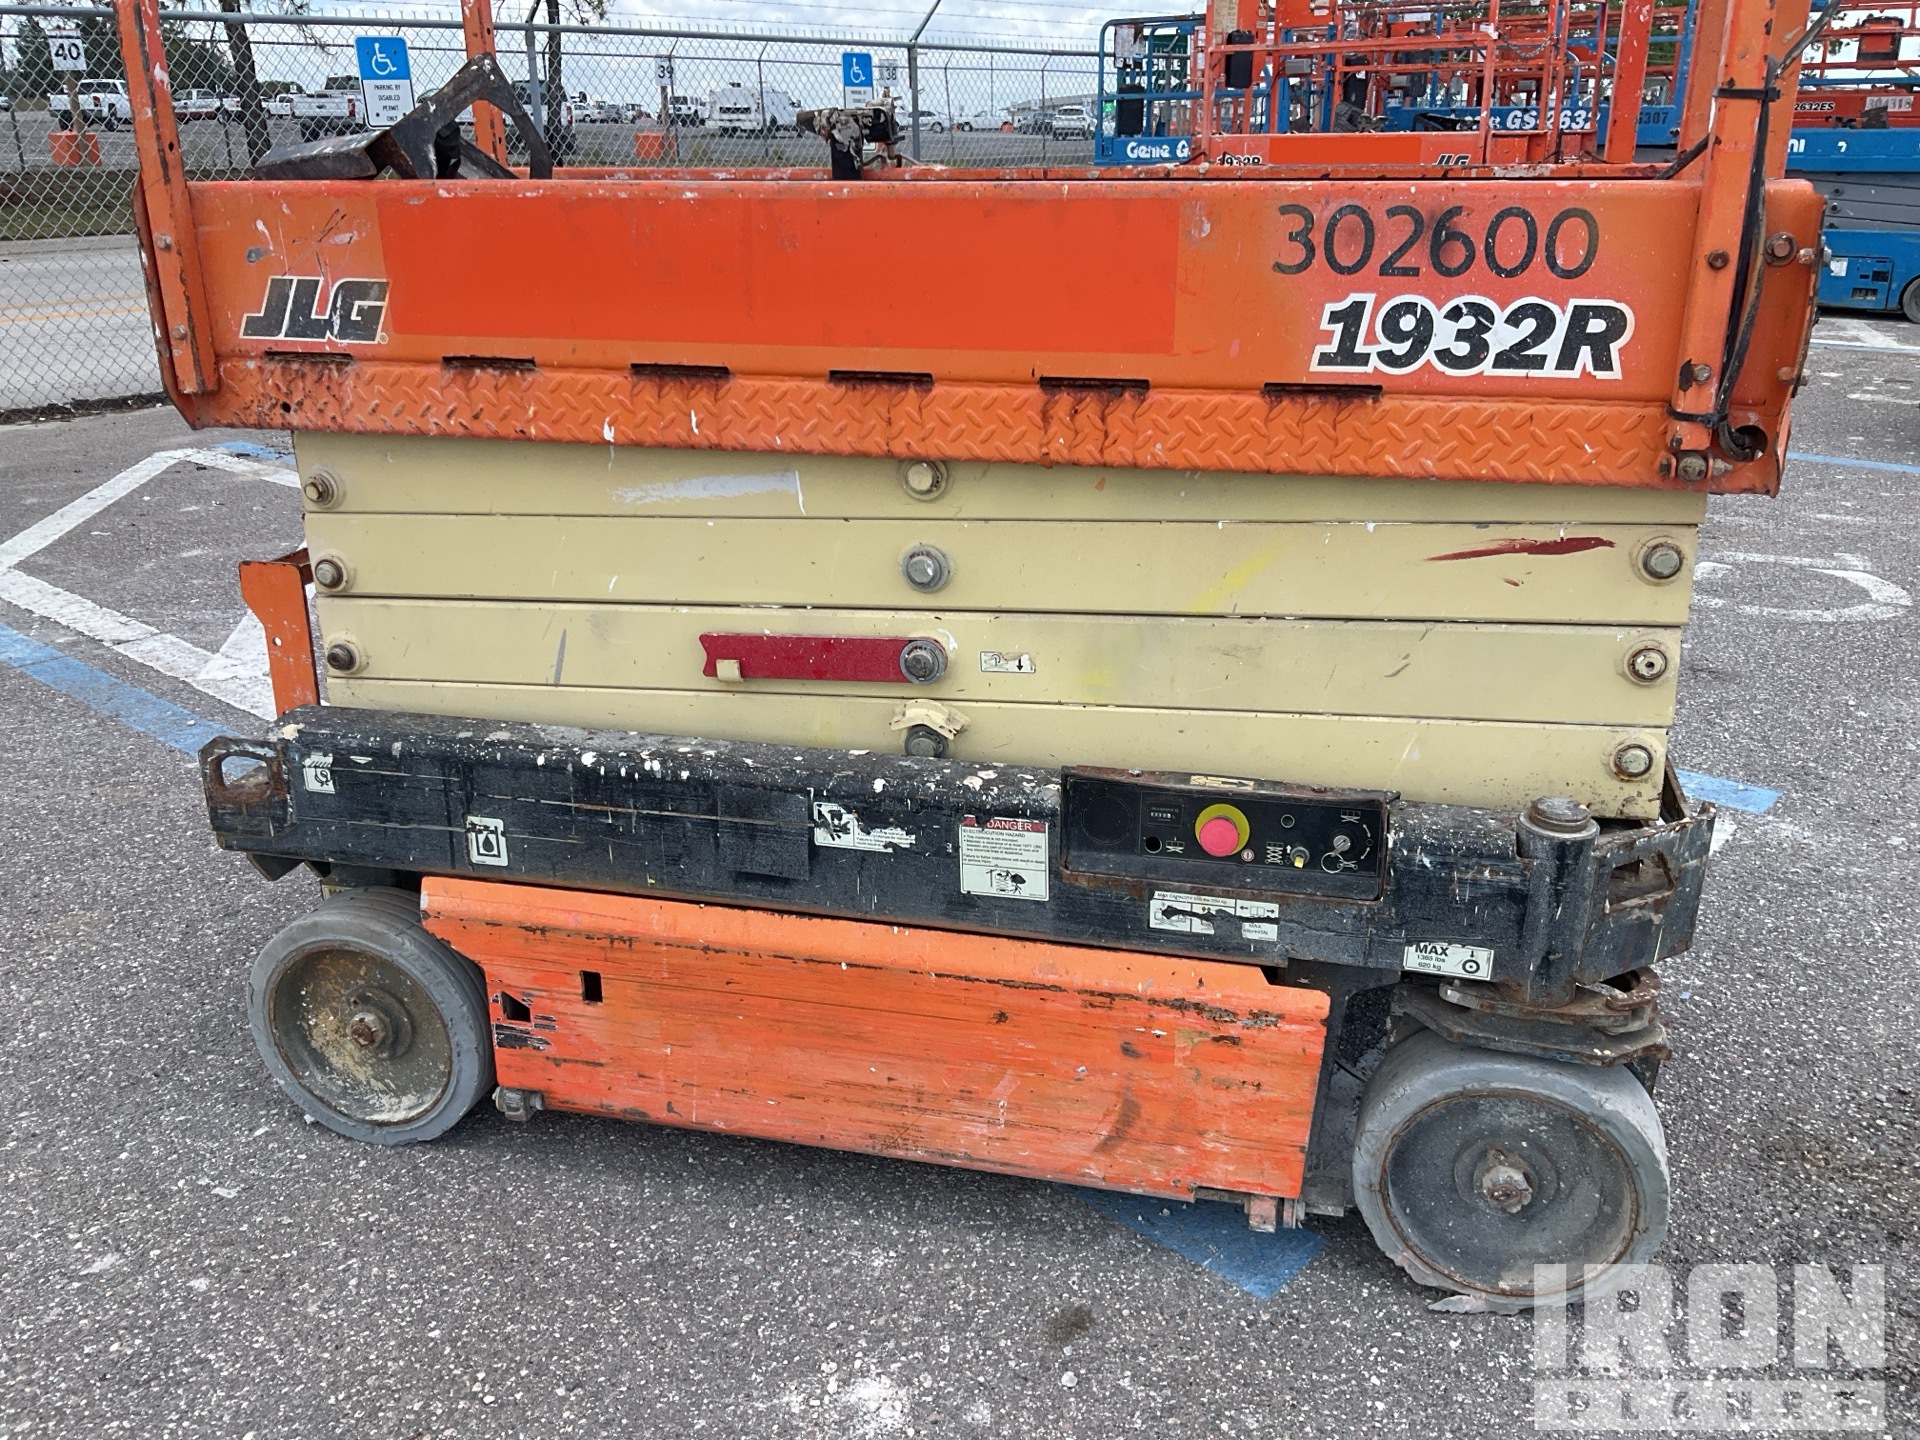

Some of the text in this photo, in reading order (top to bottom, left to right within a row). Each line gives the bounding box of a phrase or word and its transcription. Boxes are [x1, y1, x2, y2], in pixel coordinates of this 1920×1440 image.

[54, 42, 81, 61] 40
[658, 65, 674, 79] 39
[1126, 141, 1171, 159] Genie
[1272, 204, 1600, 280] 302600
[240, 275, 391, 344] JLG
[1311, 294, 1633, 378] 1932R
[987, 819, 1032, 831] DANGER
[1415, 943, 1449, 957] MAX
[1417, 954, 1446, 963] 1365 lbs
[1418, 961, 1442, 971] 620 kg
